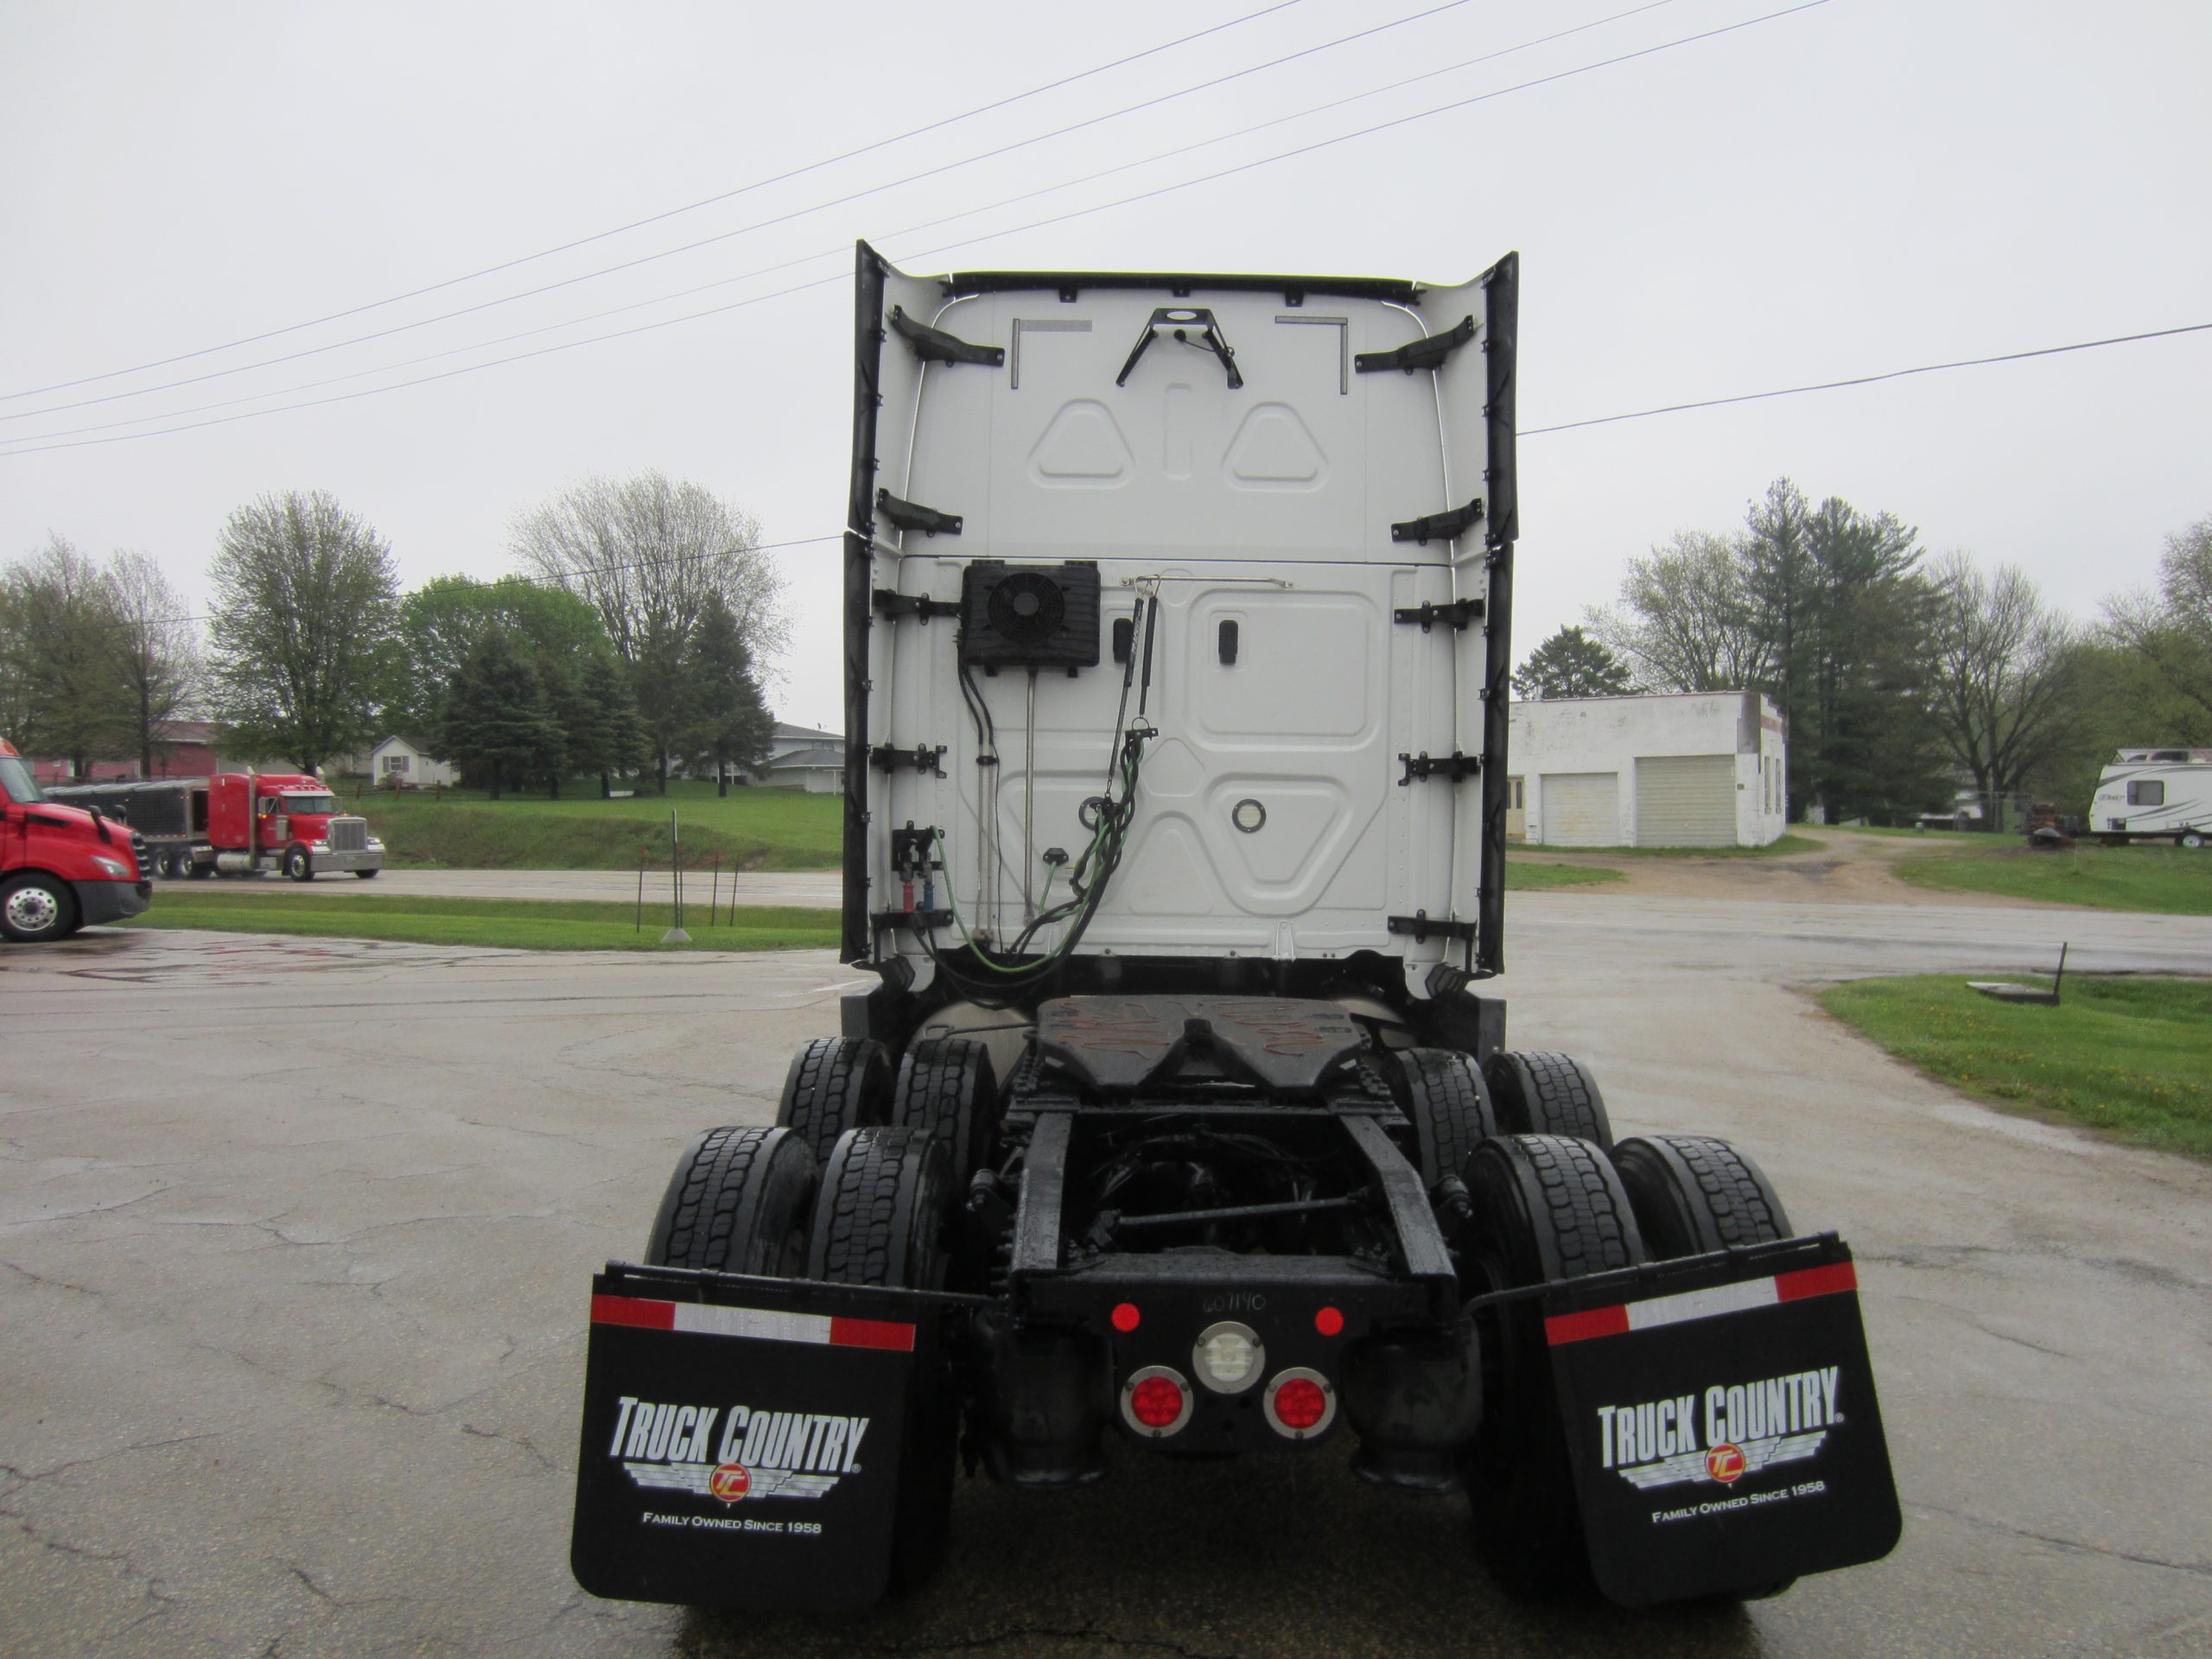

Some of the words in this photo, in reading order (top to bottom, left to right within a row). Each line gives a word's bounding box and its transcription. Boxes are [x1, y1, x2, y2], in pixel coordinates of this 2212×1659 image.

[609, 1395, 720, 1463] TRUCK
[718, 1405, 870, 1473] COUNTRY
[1597, 1394, 1697, 1468] TRUCK
[1705, 1365, 1840, 1446] COUNTRY
[642, 1511, 690, 1527] FAMILY
[691, 1516, 742, 1529] OWNED
[743, 1519, 785, 1533] SINCE
[786, 1522, 823, 1535] 1958
[1651, 1505, 1698, 1523] FAMILY
[1698, 1497, 1750, 1516] OWNED
[1749, 1488, 1789, 1505] SINCE
[1790, 1480, 1826, 1497] 1958
